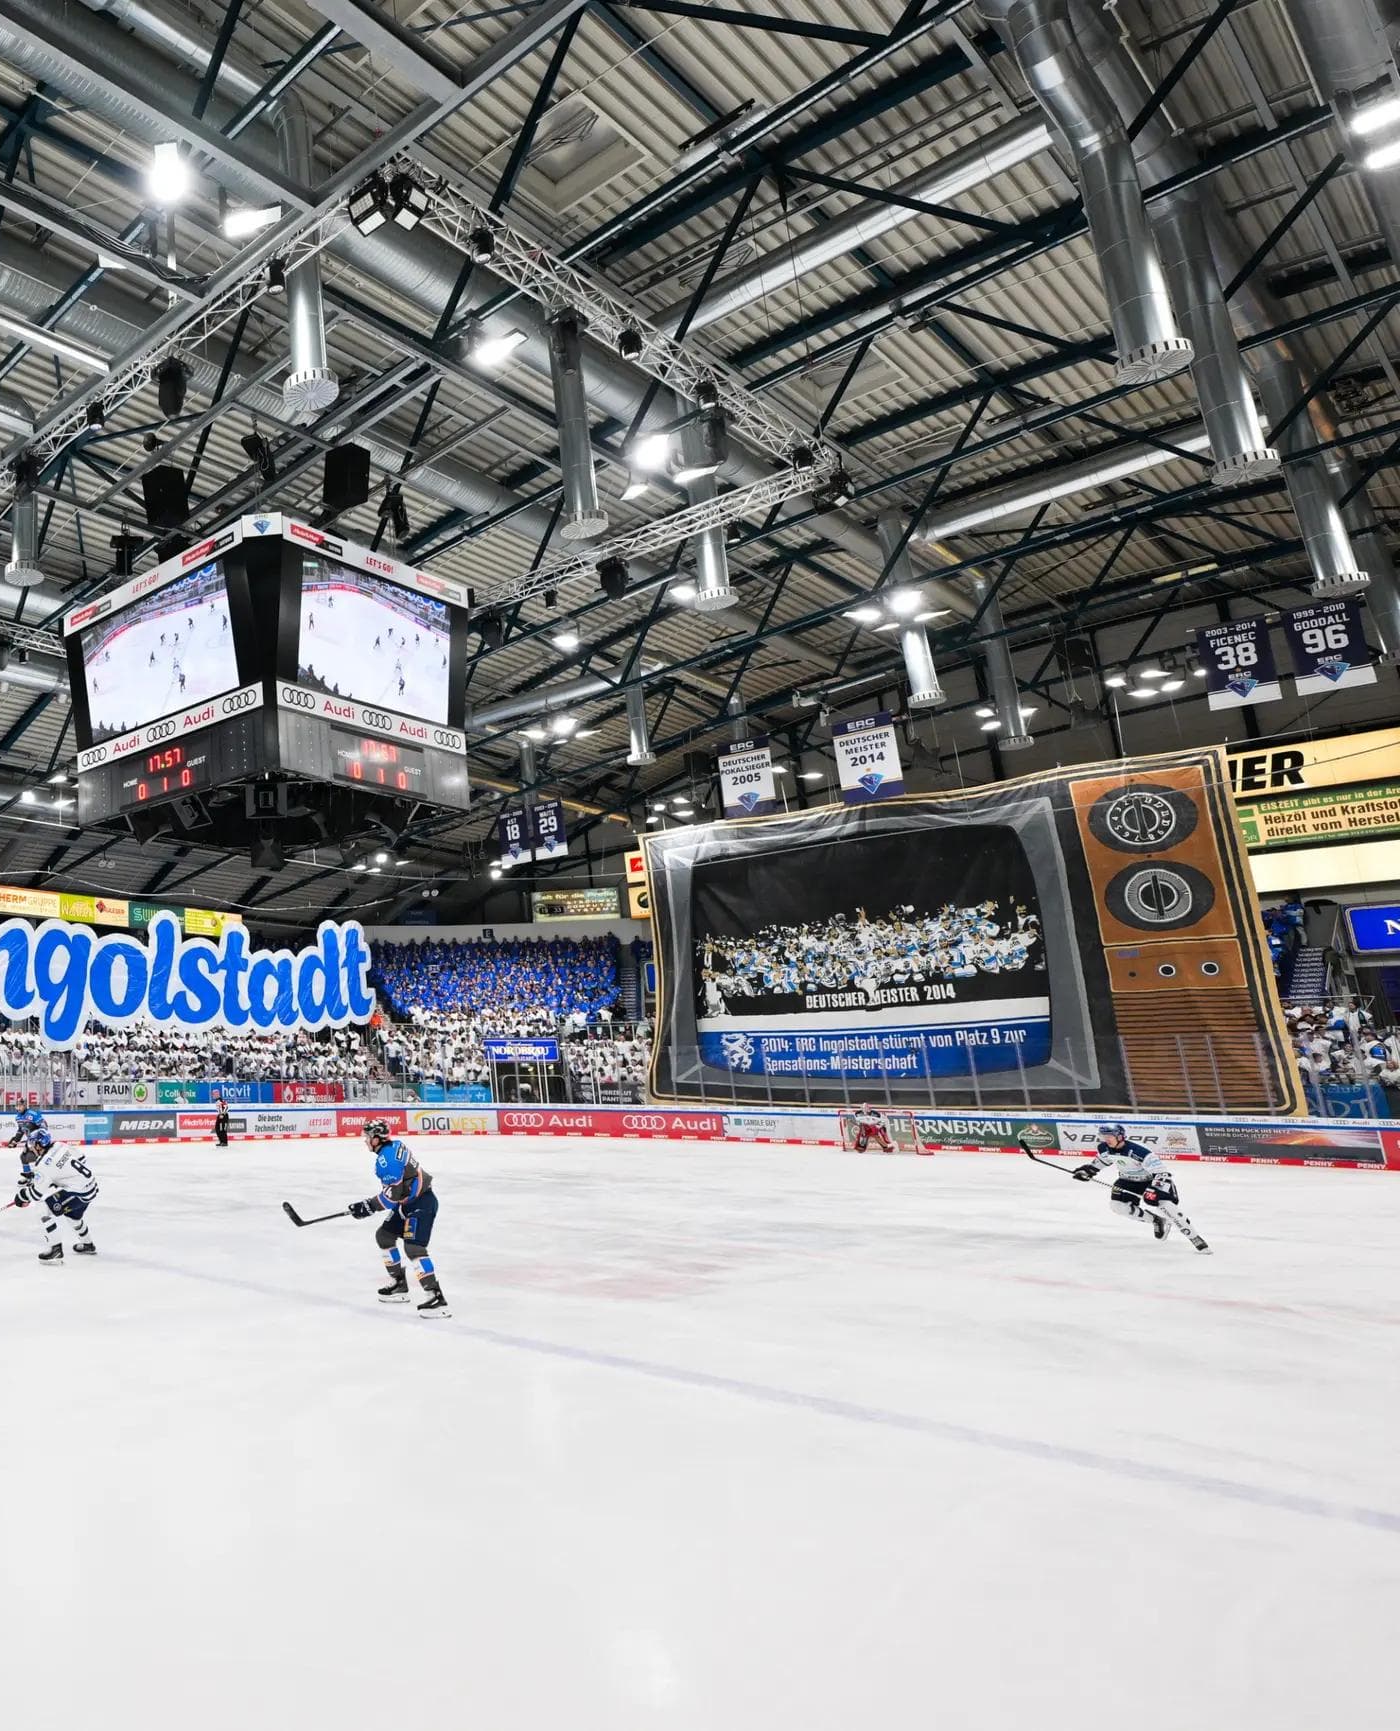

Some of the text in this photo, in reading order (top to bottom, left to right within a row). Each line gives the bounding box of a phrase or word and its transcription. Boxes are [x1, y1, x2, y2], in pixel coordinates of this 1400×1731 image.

[1293, 613, 1350, 632] GOODALL
[1210, 631, 1257, 648] FICENEC
[1301, 623, 1350, 654] 96
[1214, 642, 1259, 671] 38
[324, 701, 428, 739] Audi Audi
[847, 718, 875, 731] ERC
[113, 706, 214, 754] Audi Audi
[730, 740, 754, 751] ERC
[839, 732, 890, 747] DEUTSCHER
[845, 742, 887, 755] MEISTER
[187, 755, 206, 768] GUEST
[721, 761, 770, 775] POKALSIEGER
[722, 754, 766, 767] DEUTSCHER
[850, 752, 885, 767] 2014
[353, 762, 361, 778] 0
[398, 772, 407, 789] 0
[404, 766, 421, 775] GUEST
[138, 783, 146, 799] 0
[181, 770, 190, 786] 0
[731, 773, 761, 786] 2005
[1261, 799, 1299, 811] EISZEIT
[1336, 794, 1352, 802] nur
[1355, 791, 1364, 799] in
[1367, 789, 1382, 797] der
[1264, 807, 1337, 825] Heizöl und
[506, 824, 520, 841] 18
[539, 816, 558, 834] 29
[1267, 823, 1307, 837] direkt
[1312, 820, 1342, 831] vom
[806, 983, 956, 1009] DEUTSCHER MEISTER 2014
[761, 1038, 793, 1053] 2014:
[796, 1037, 816, 1053] ERC
[820, 1034, 879, 1054] Ingolstadt
[929, 1033, 952, 1048] von
[956, 1030, 989, 1047] Platz
[992, 1028, 1001, 1044] 9
[1004, 1028, 1027, 1045] zur
[765, 1053, 918, 1072] Sensations-Meisterschaft
[119, 1120, 175, 1131] MBDA
[548, 1114, 593, 1128] Audi
[672, 1115, 717, 1131] Audi
